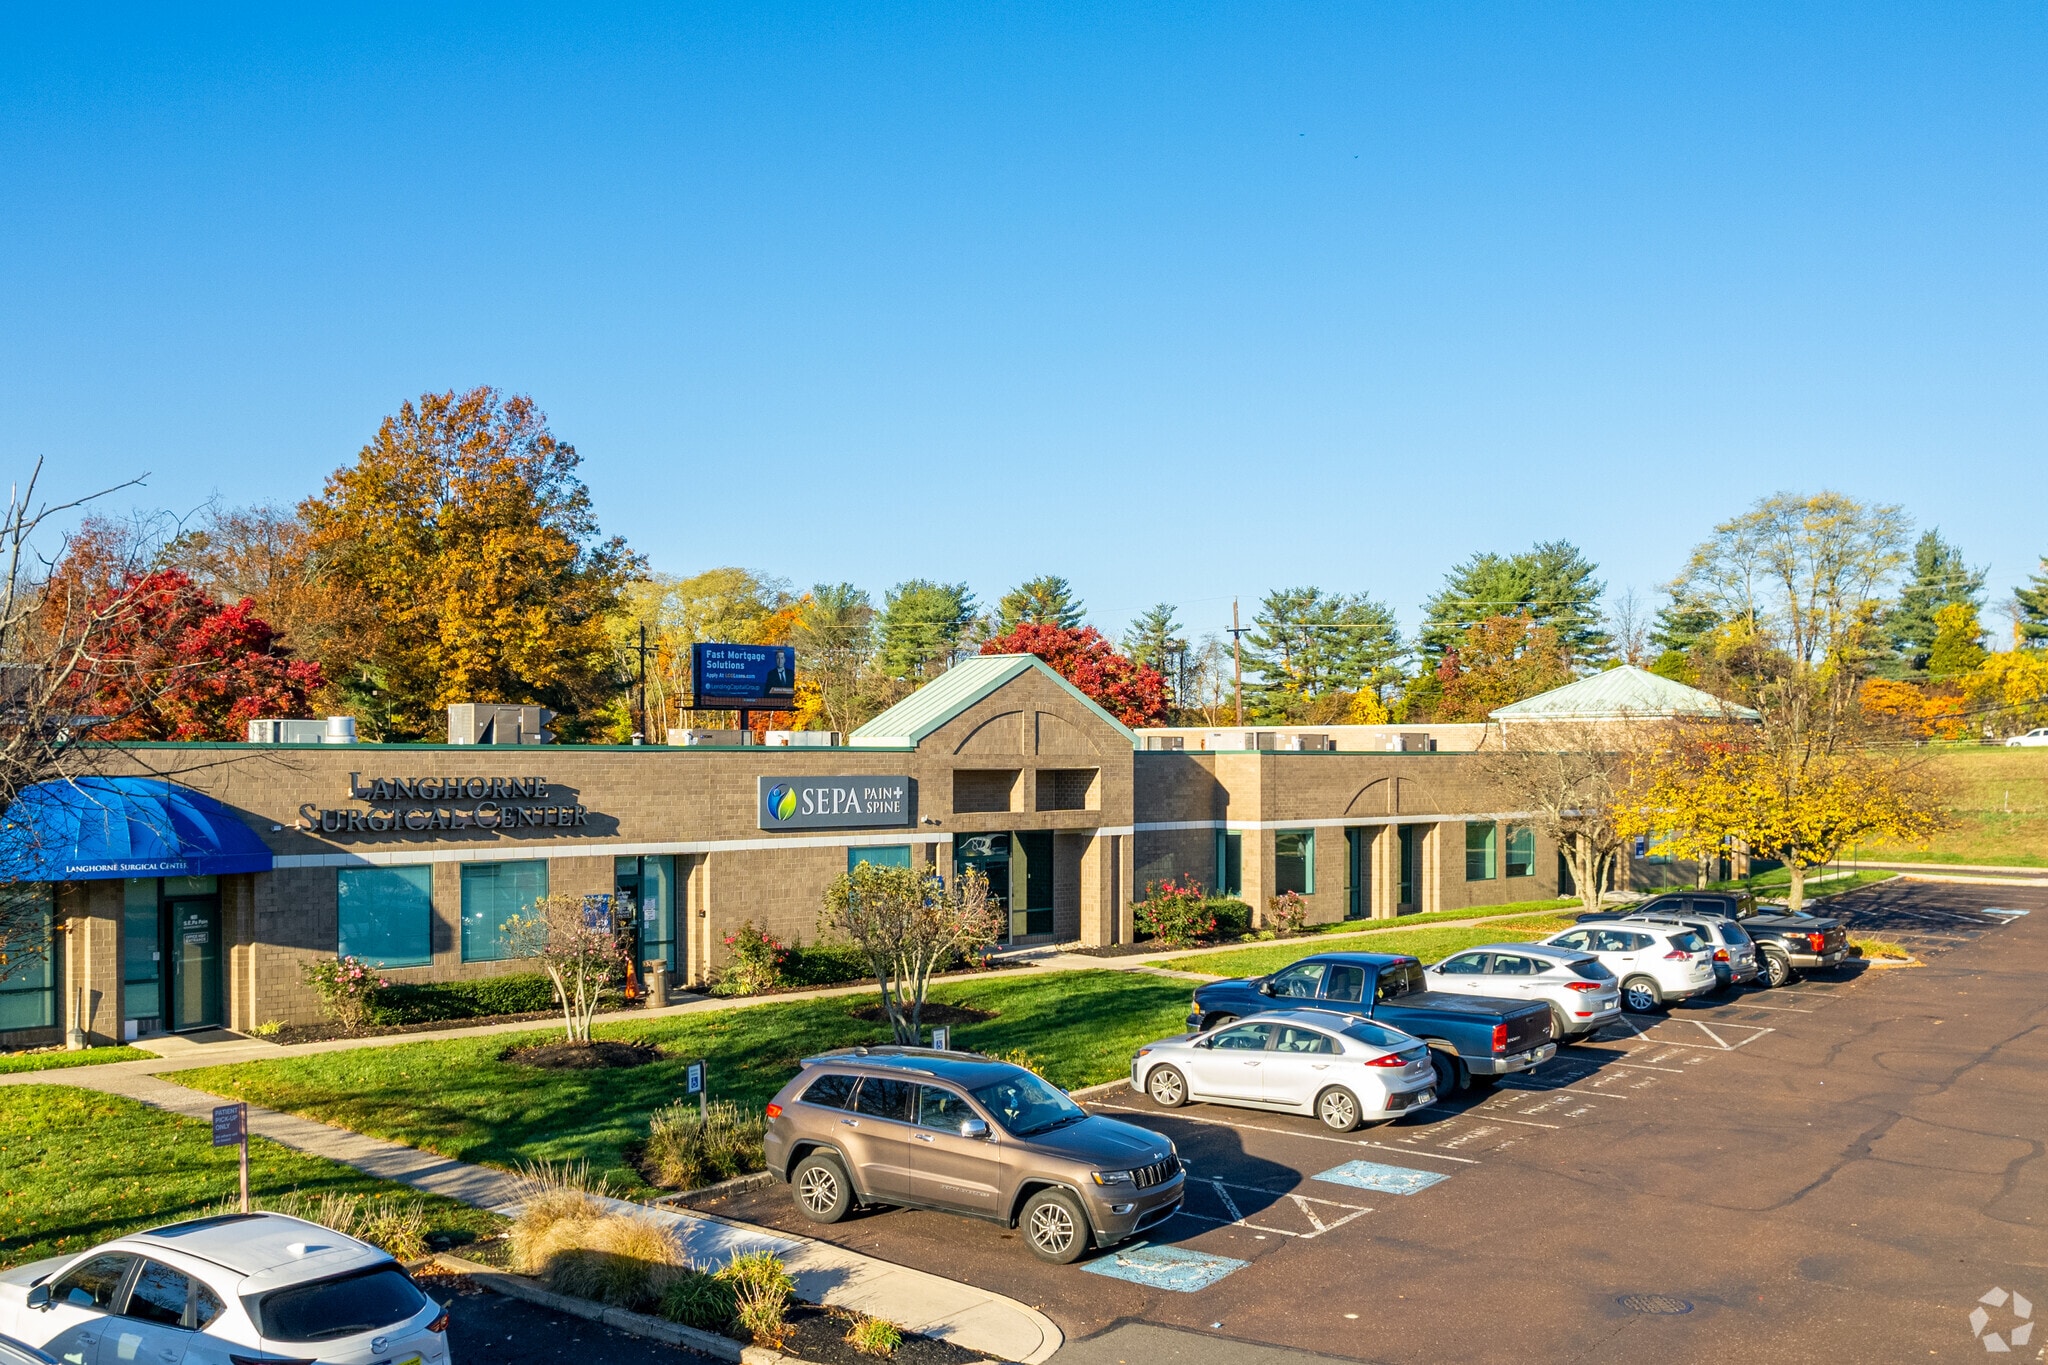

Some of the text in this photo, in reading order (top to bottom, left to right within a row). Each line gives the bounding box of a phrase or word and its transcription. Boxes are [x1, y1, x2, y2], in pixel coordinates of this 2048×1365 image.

[706, 650, 766, 662] Fast Mortgage
[706, 661, 745, 670] Solutions
[348, 771, 548, 801] LANGHORNE
[801, 787, 863, 816] SEPA
[866, 800, 901, 814] SPINE
[299, 801, 590, 834] SURGICAL CENTER
[65, 861, 189, 873] LANGHORNE SURGICAL CENTER
[214, 1107, 238, 1116] PATIENT
[214, 1114, 238, 1123] PICK-UP
[215, 1122, 230, 1131] ONLY
